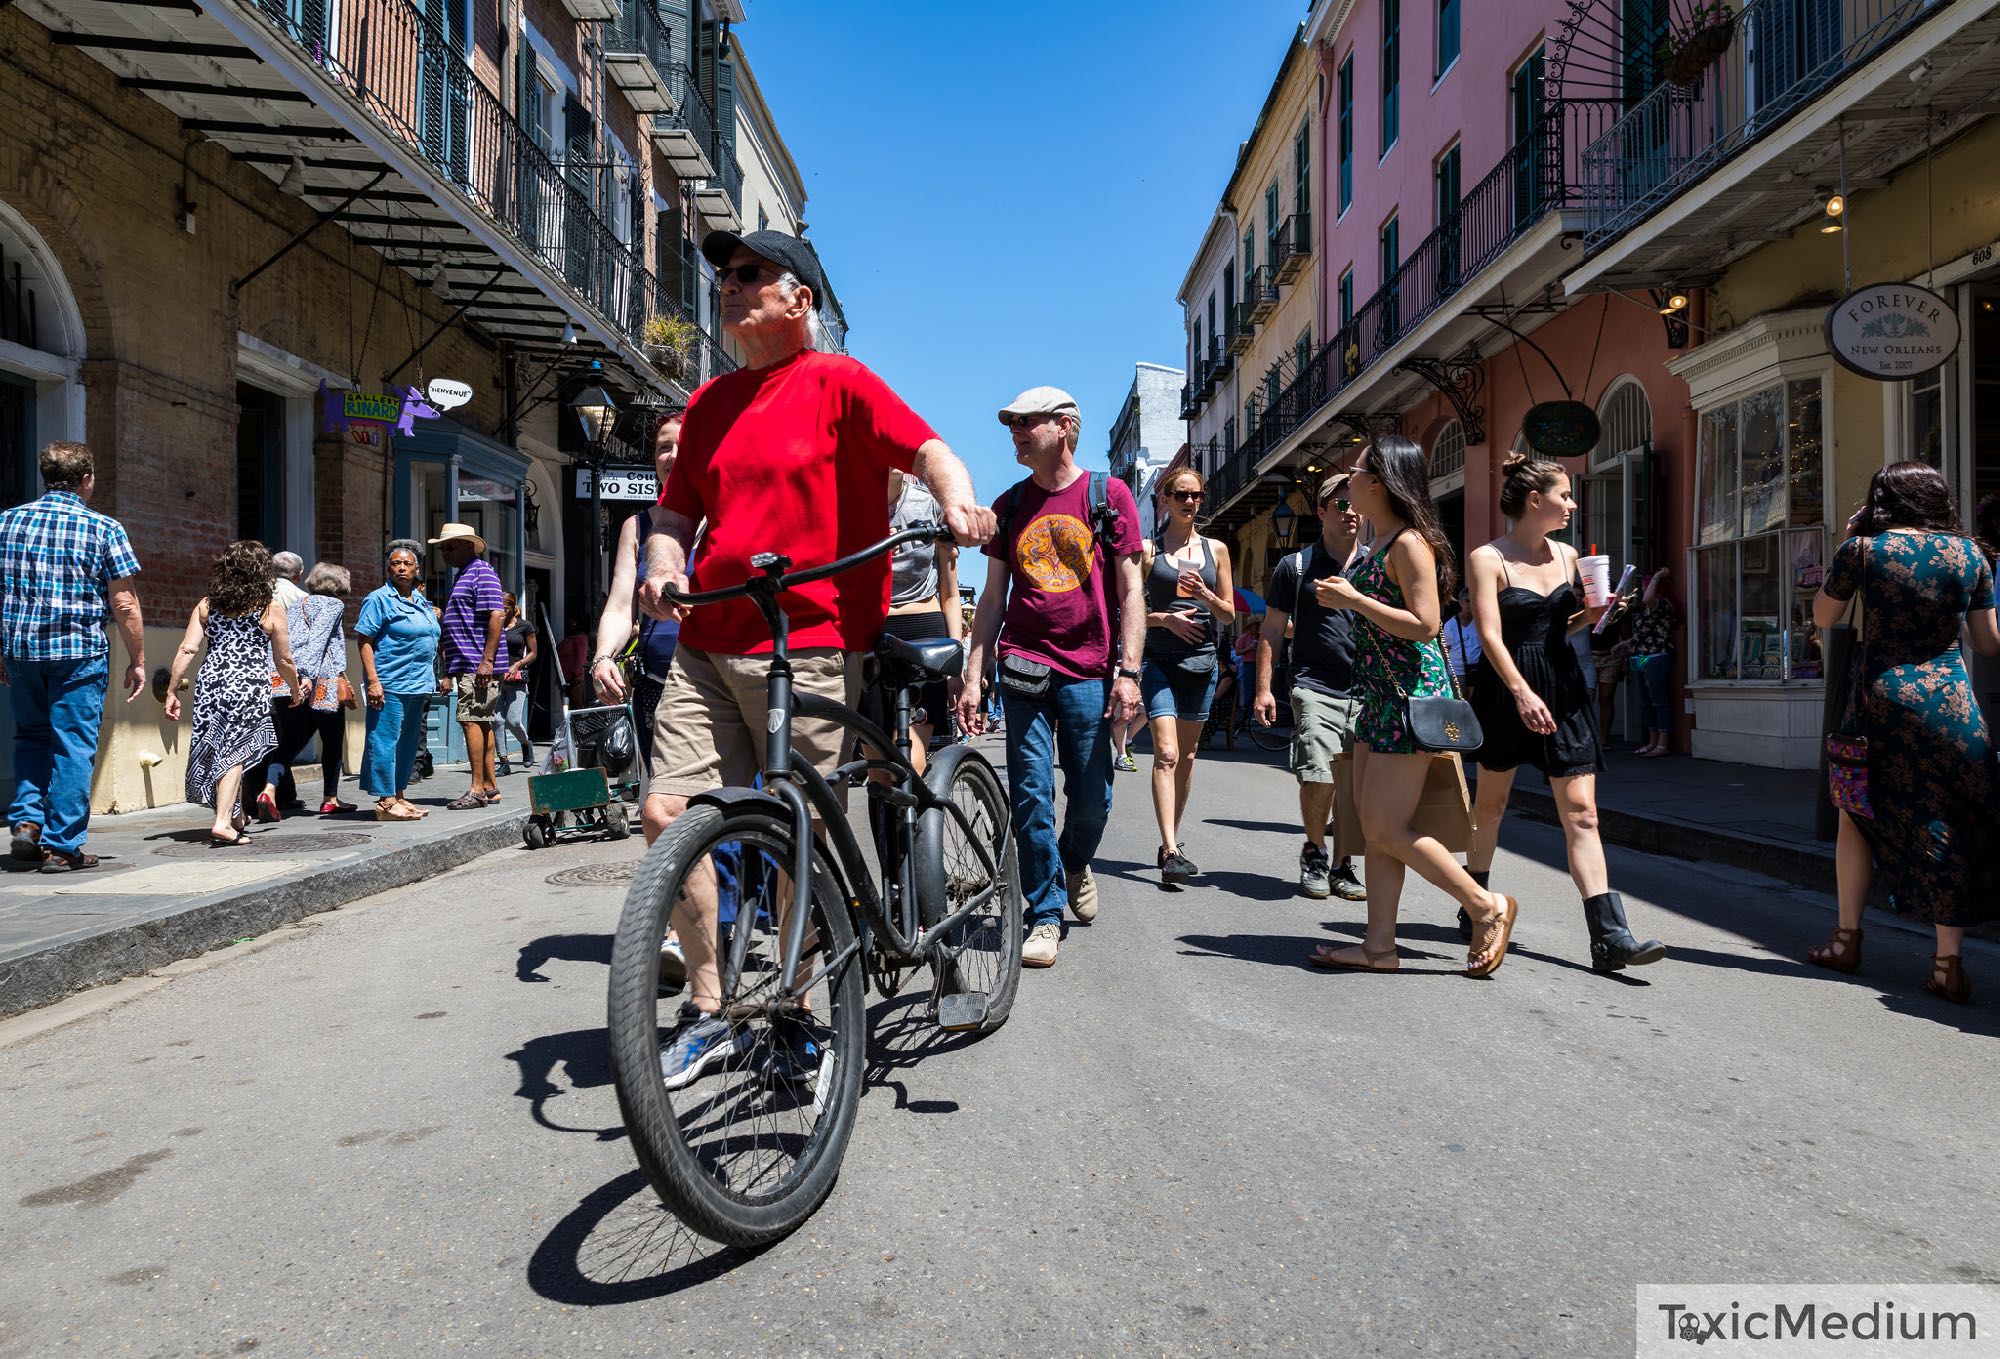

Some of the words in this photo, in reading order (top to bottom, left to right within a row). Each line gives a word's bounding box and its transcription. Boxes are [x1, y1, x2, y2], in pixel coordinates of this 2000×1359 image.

[1972, 246, 1992, 265] 608
[1848, 294, 1940, 325] FOREVER
[1895, 361, 1913, 370] 2007
[348, 394, 399, 406] GALLERY
[346, 402, 399, 419] RINARD
[627, 471, 656, 481] Cou
[627, 483, 657, 495] SIS
